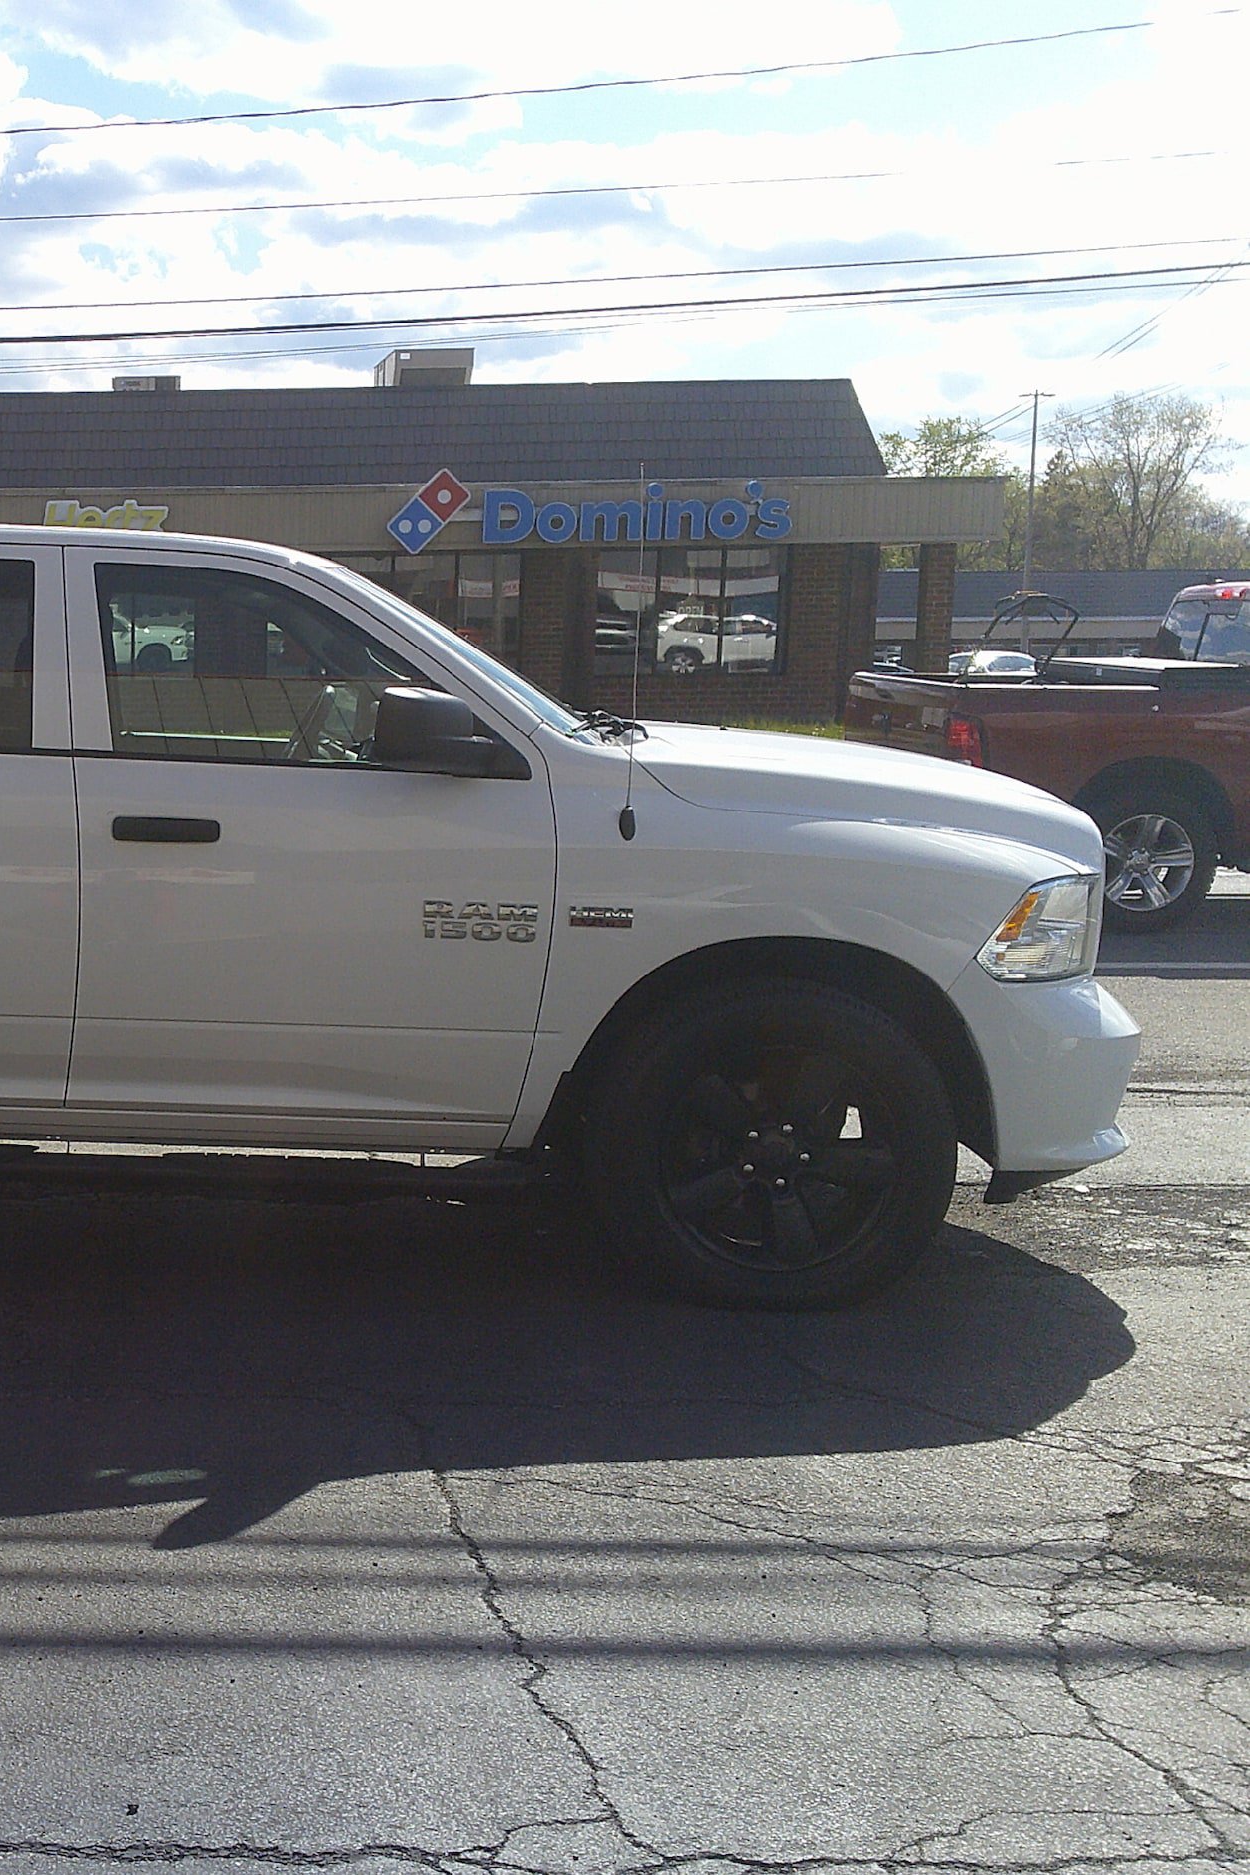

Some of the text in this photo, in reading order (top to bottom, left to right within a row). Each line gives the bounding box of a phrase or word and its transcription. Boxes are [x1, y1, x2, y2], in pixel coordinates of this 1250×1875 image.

[45, 501, 167, 531] Hertz
[483, 482, 793, 544] Domino's
[423, 900, 538, 922] RAM
[570, 906, 634, 918] HEMI
[422, 920, 536, 943] 1500
